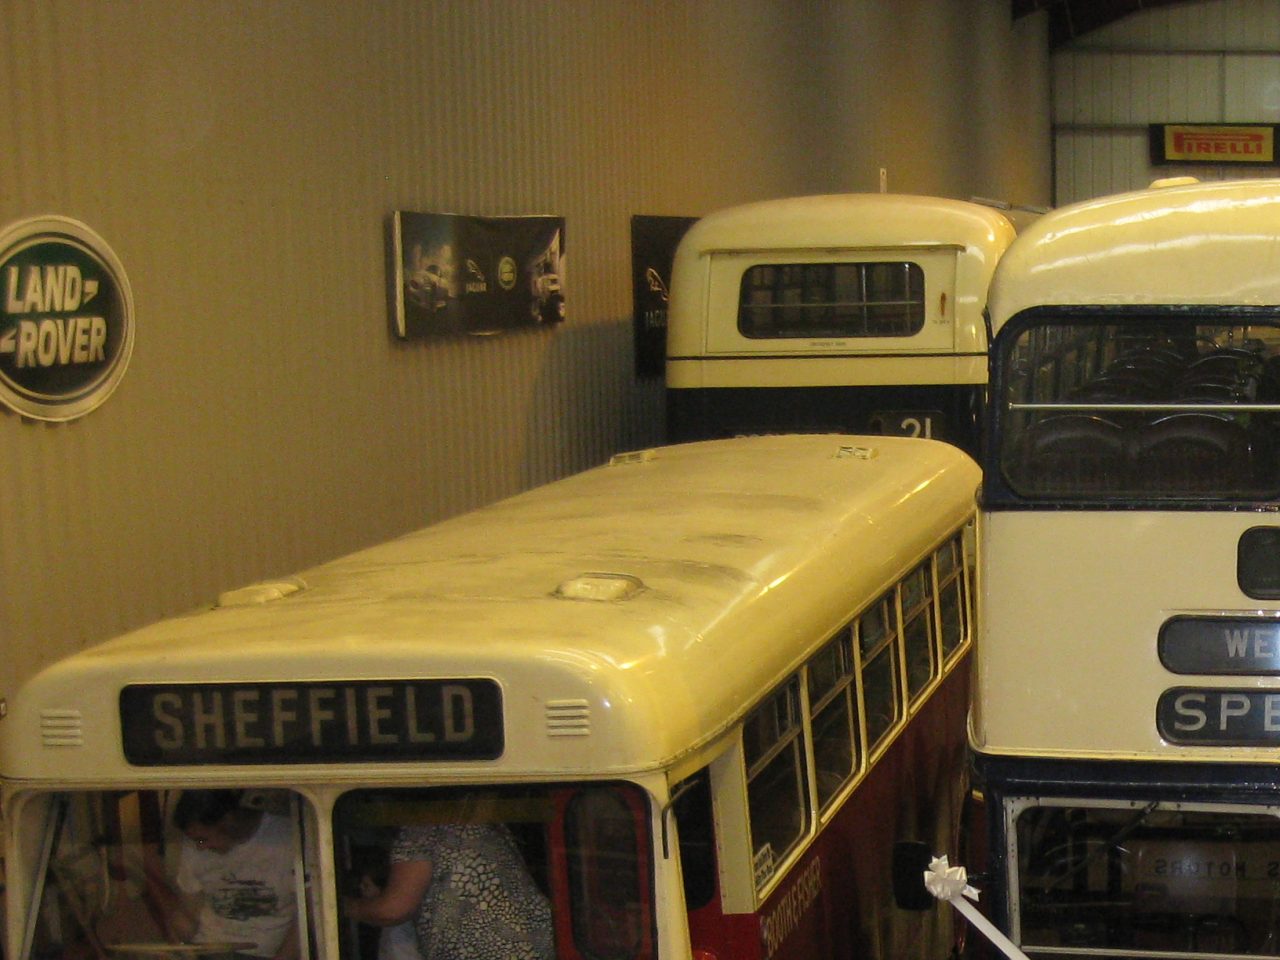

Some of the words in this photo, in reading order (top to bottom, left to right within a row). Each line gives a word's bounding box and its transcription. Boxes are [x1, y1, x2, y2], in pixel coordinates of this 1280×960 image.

[1173, 132, 1265, 155] PIRELLI
[6, 265, 82, 315] LAND
[16, 317, 108, 368] ROVER
[152, 685, 476, 750] SHEFFIELD
